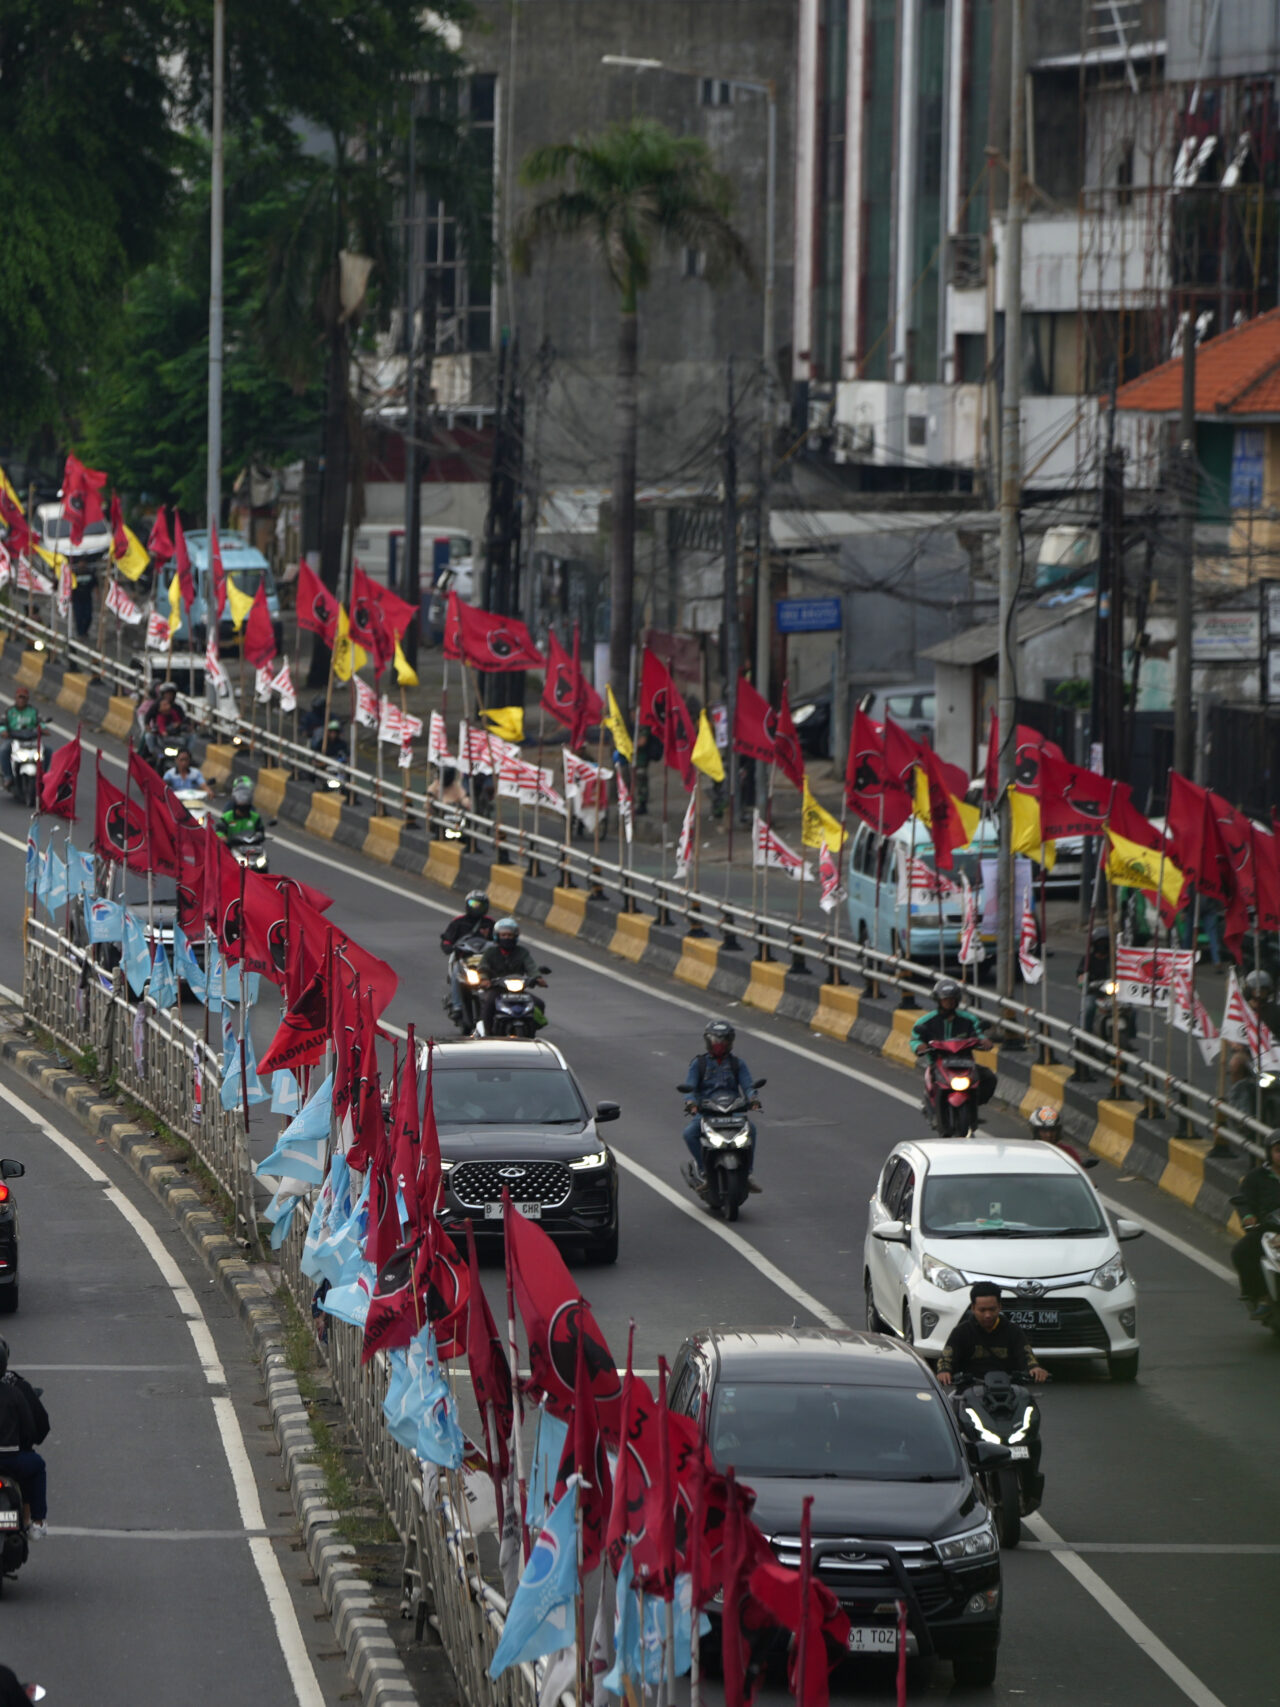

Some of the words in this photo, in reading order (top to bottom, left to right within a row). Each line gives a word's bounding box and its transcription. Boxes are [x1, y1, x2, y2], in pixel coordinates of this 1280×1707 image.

[486, 1204, 492, 1214] B
[1009, 1311, 1035, 1323] 2945
[871, 1630, 895, 1644] TOZ
